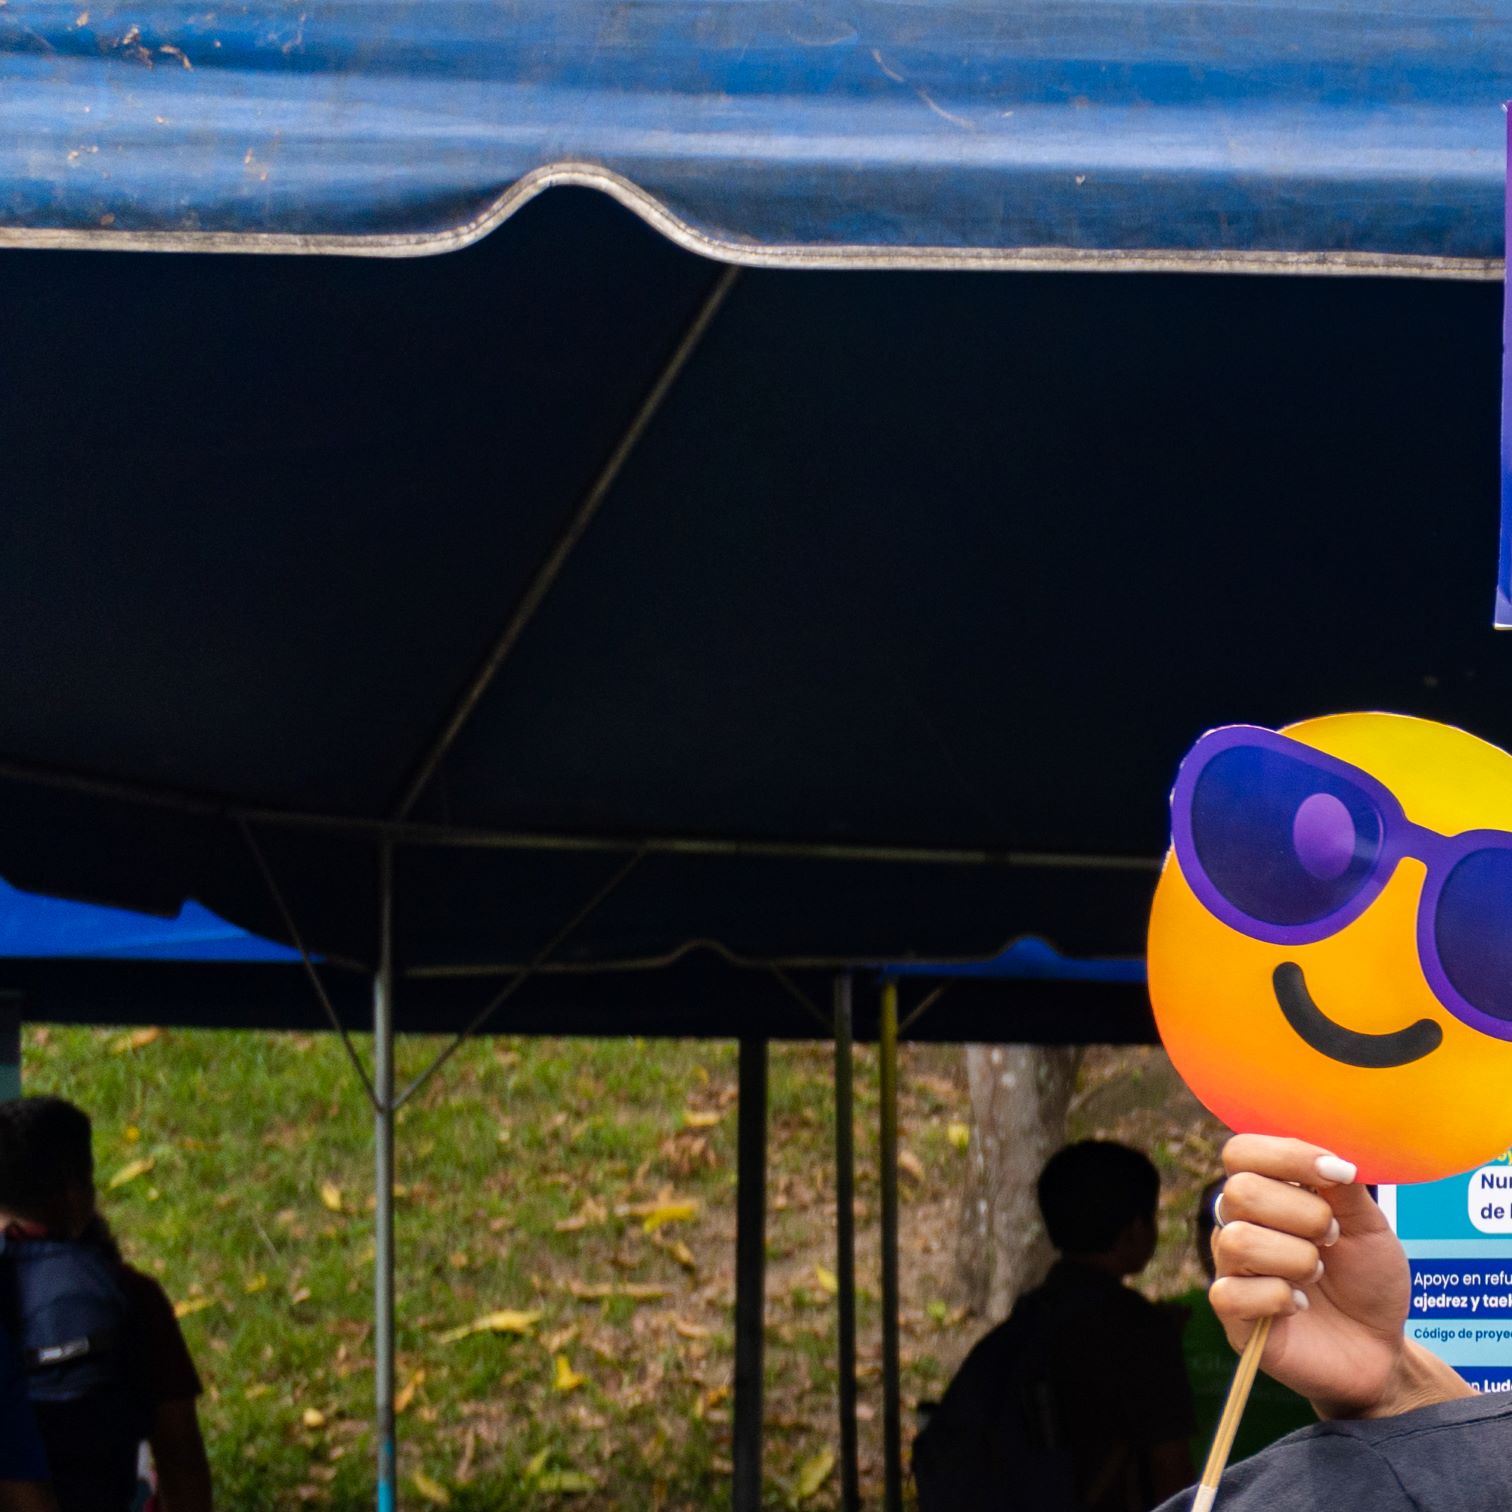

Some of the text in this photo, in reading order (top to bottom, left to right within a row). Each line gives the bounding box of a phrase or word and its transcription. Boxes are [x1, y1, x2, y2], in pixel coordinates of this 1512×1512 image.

[1480, 1202, 1505, 1219] de
[1414, 1272, 1459, 1288] Apoyo
[1463, 1274, 1481, 1285] en
[1413, 1293, 1468, 1311] ajedrez
[1470, 1296, 1481, 1311] y
[1413, 1327, 1455, 1342] Código
[1458, 1327, 1473, 1340] de
